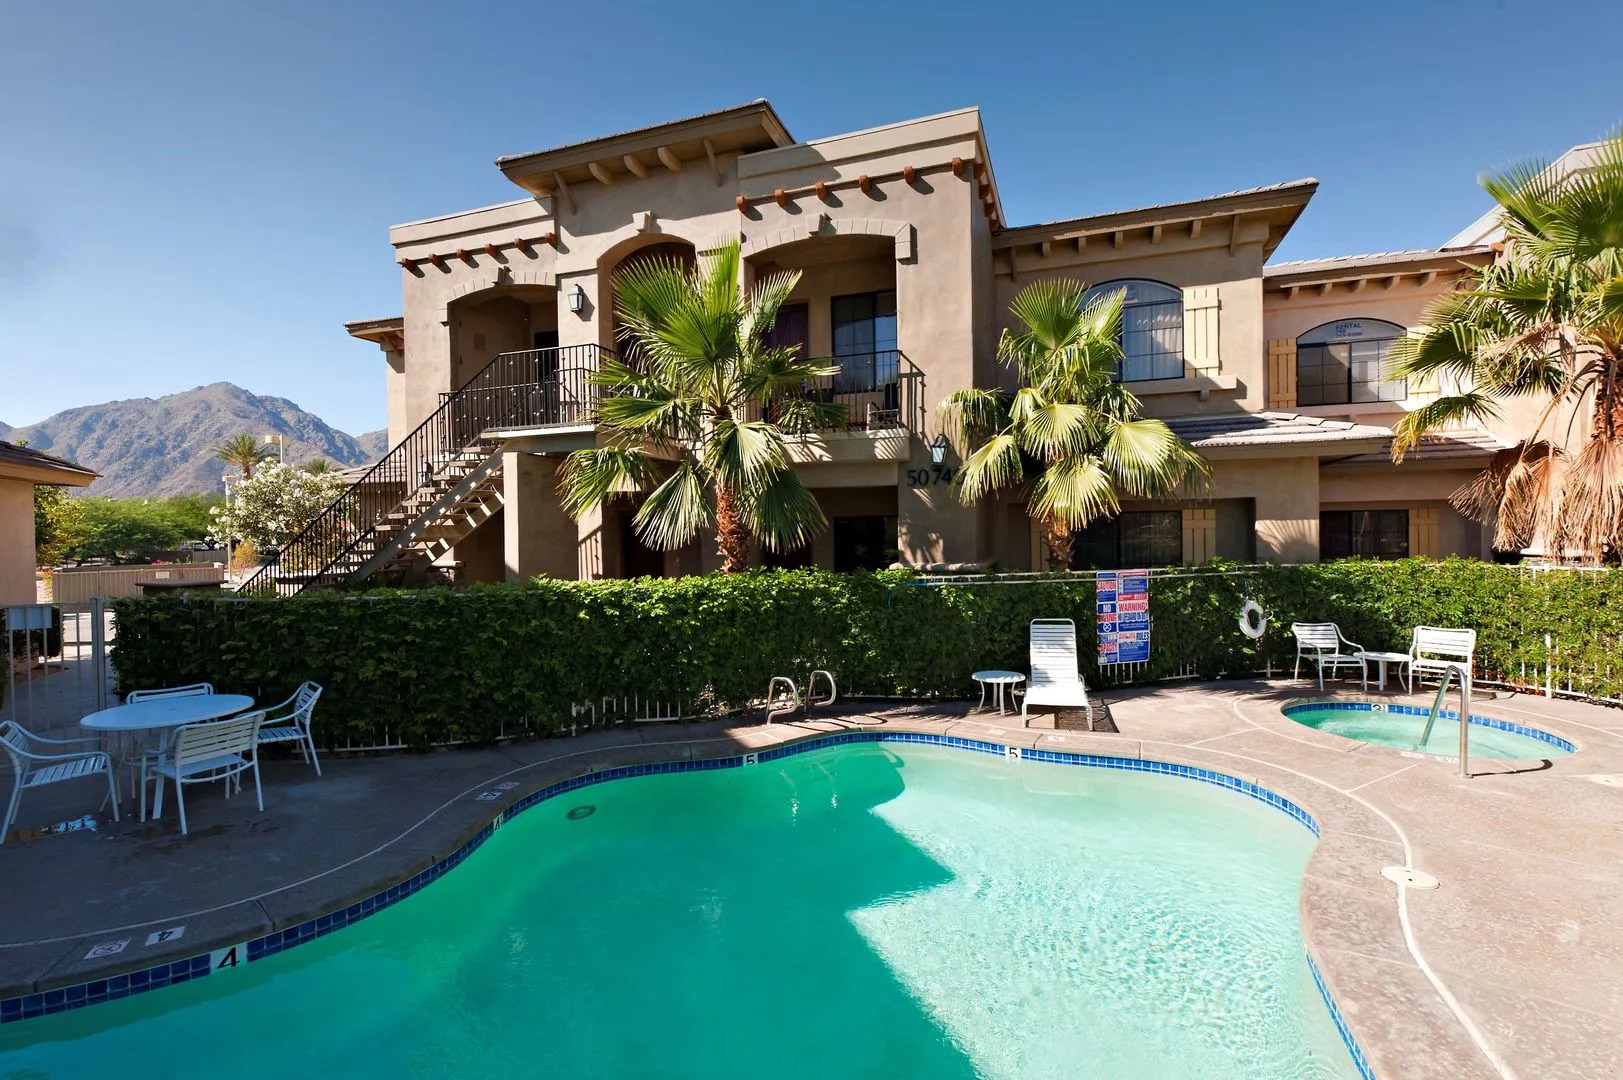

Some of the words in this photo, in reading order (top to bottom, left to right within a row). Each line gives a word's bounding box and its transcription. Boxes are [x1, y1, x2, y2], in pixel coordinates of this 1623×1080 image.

[1335, 322, 1362, 330] RENTAL
[907, 468, 964, 486] 5074
[1103, 604, 1112, 613] NO
[1009, 747, 1018, 758] 5
[746, 754, 755, 765] 5
[157, 929, 174, 942] 4
[216, 947, 241, 969] 4
